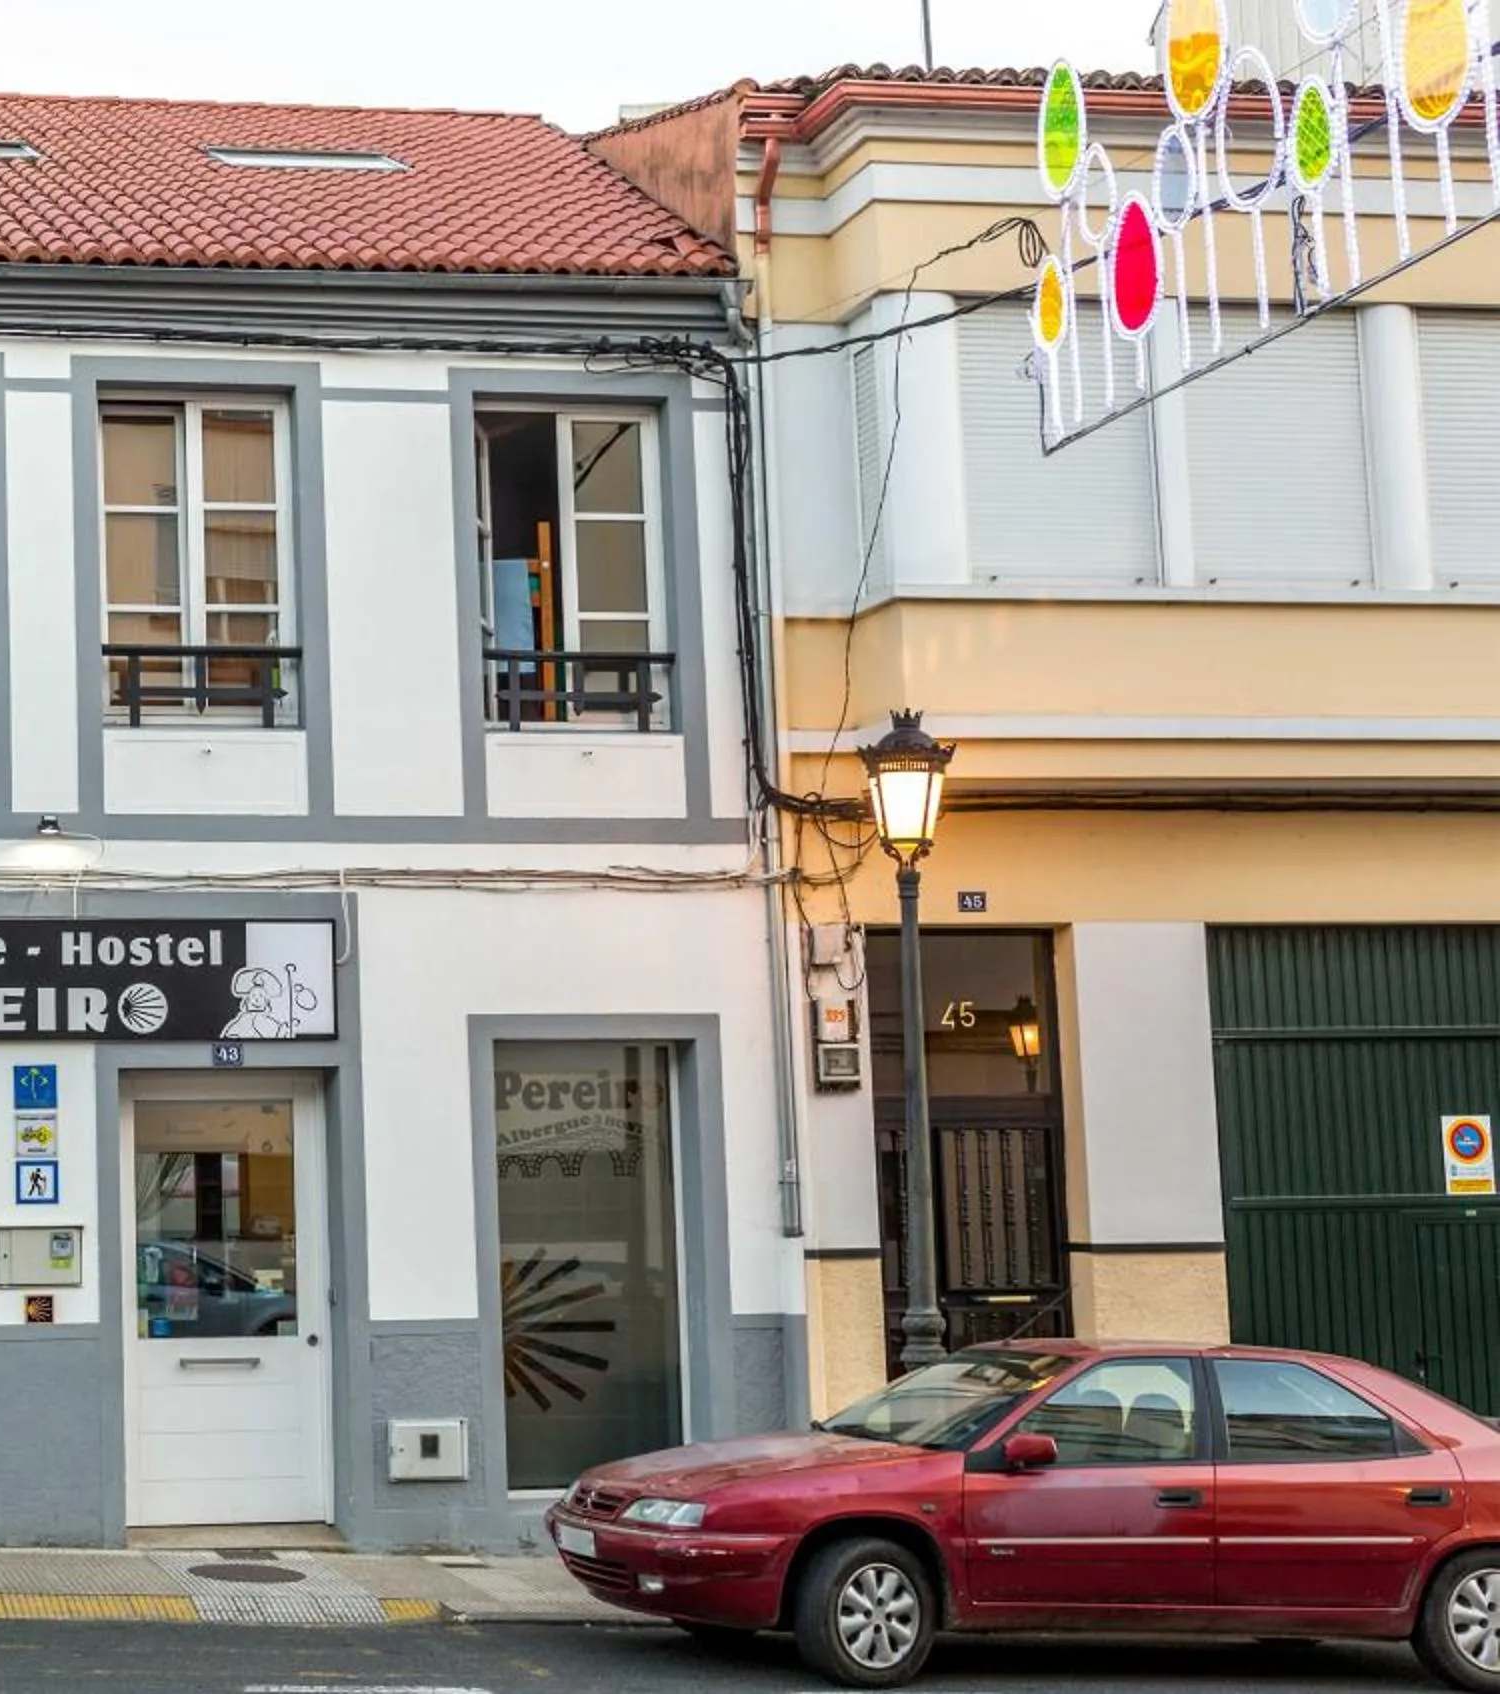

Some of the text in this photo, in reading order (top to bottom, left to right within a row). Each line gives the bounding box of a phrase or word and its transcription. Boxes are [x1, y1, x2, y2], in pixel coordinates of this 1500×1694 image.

[963, 895, 984, 909] 45
[61, 929, 223, 967] Hostel
[940, 1001, 976, 1030] 45
[218, 1047, 239, 1061] 43
[497, 1115, 591, 1147] Albergue
